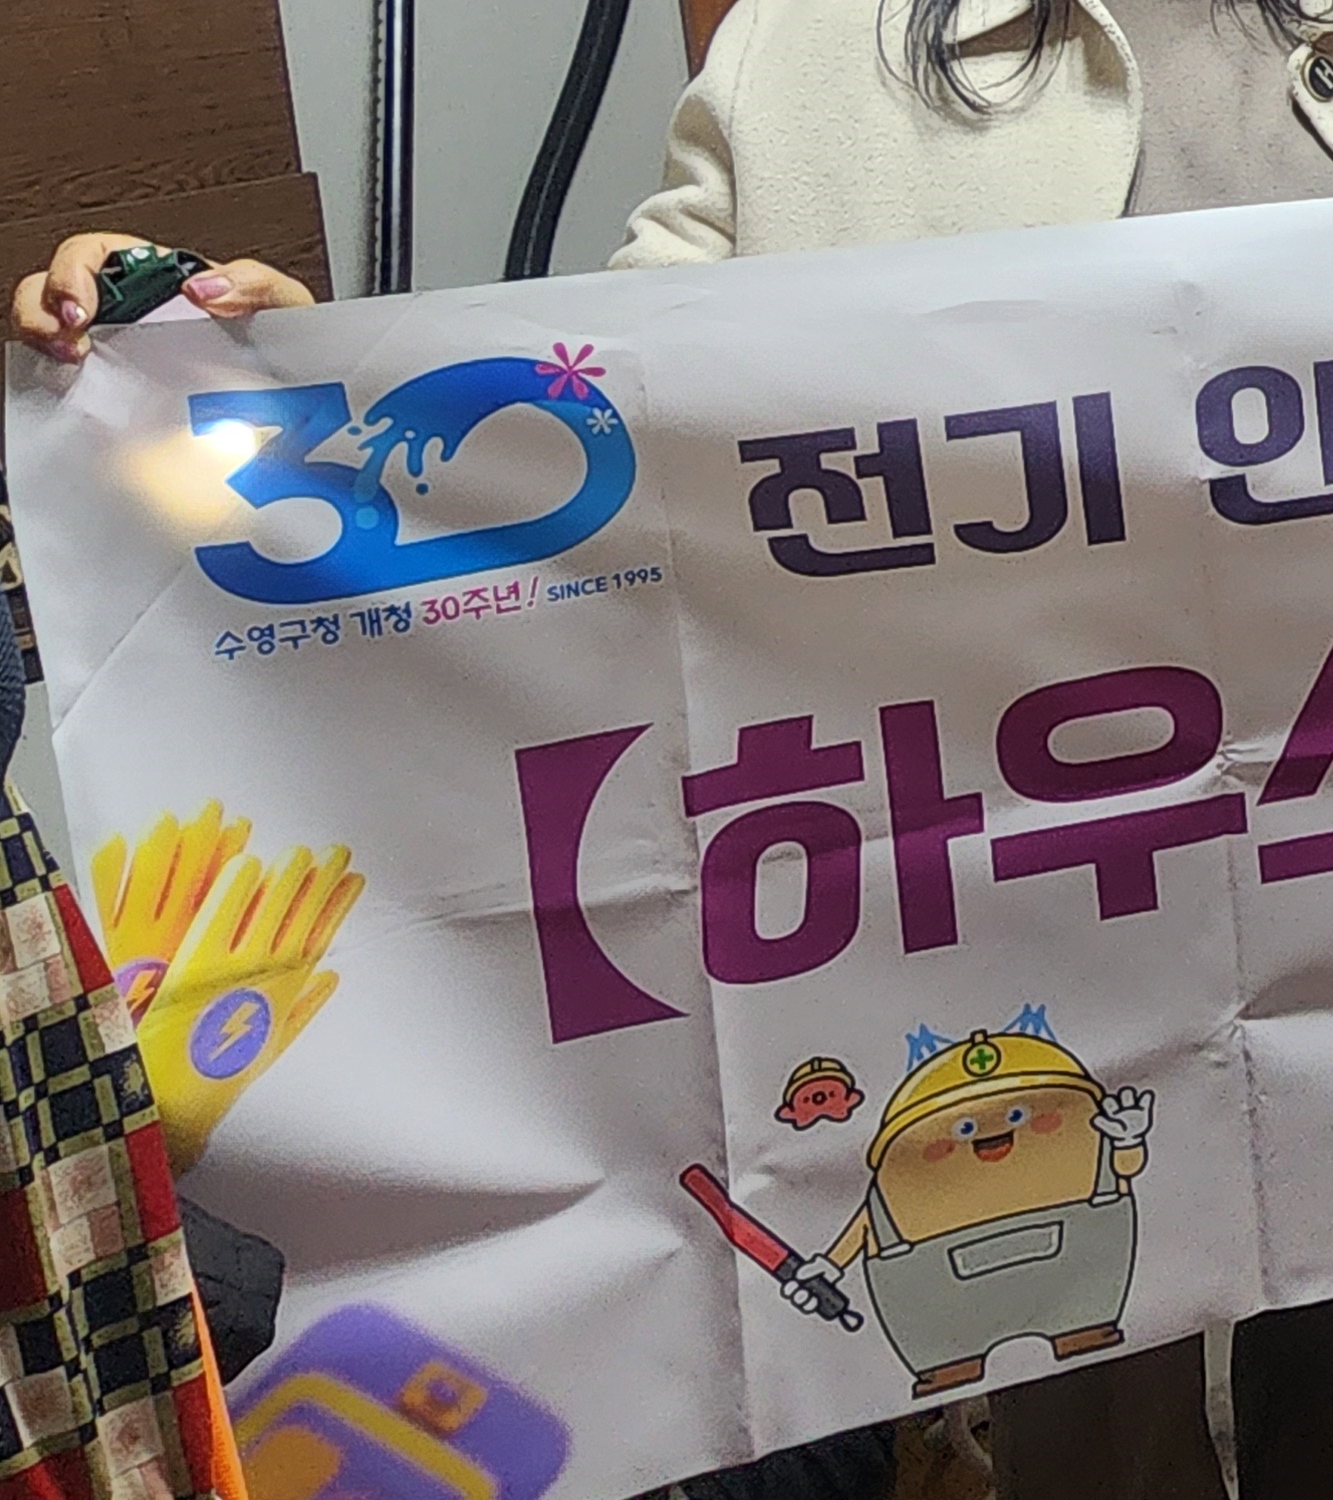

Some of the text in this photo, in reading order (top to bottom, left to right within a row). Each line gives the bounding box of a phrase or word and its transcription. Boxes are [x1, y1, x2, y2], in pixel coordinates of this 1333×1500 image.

[737, 391, 1127, 577] 전기
[546, 567, 663, 602] SINCE 1995
[214, 612, 341, 660] 수영구청
[350, 601, 412, 638] 개청
